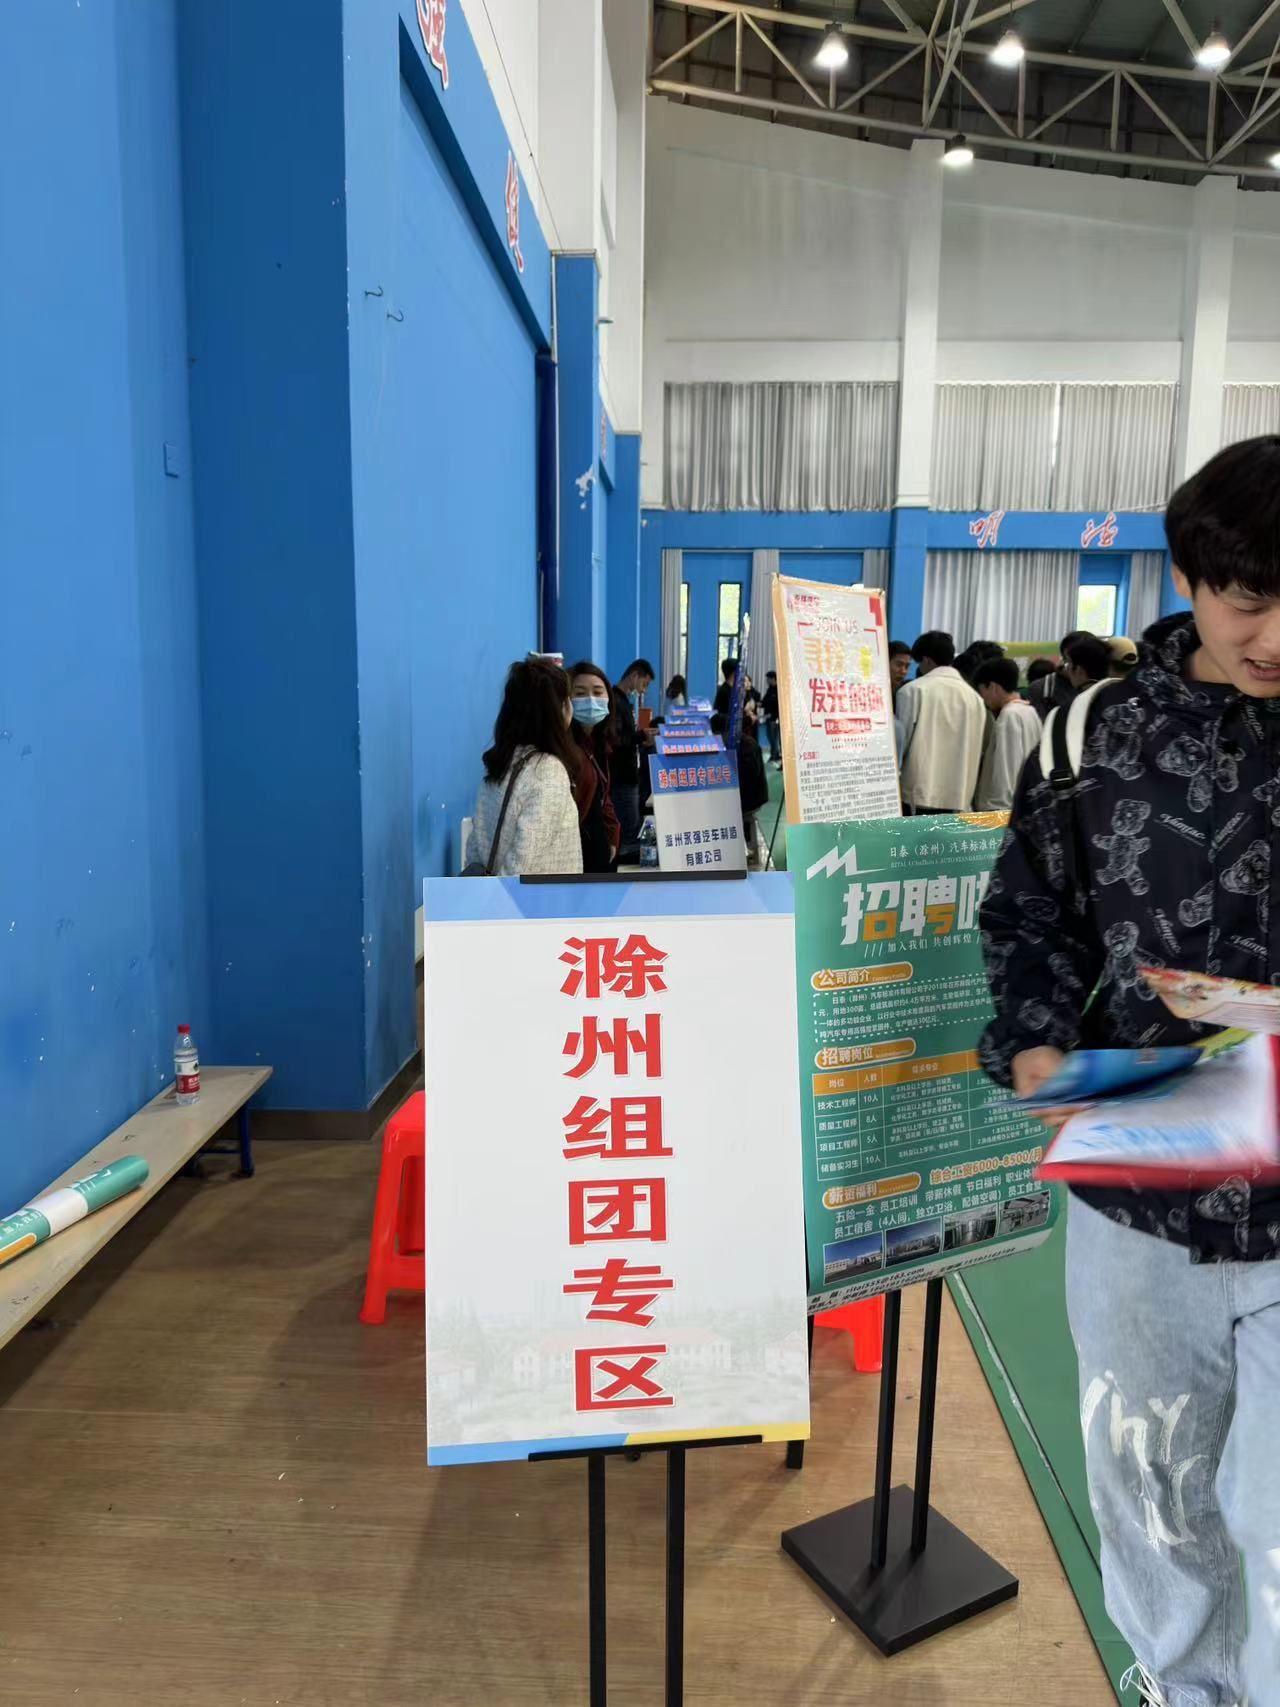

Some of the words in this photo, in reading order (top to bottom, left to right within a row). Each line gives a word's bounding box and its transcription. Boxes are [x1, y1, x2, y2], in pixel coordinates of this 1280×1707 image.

[685, 849, 722, 867] 有限公司
[888, 938, 927, 953] 加入我们
[819, 968, 870, 986] 公司简介
[822, 1047, 873, 1066] 招聘岗位
[818, 1098, 856, 1110] 技术工程师
[864, 1094, 878, 1102] 10人
[820, 1139, 858, 1152] 项目工程师
[867, 1134, 878, 1143] 5人
[821, 1159, 858, 1172] 储备实习生
[866, 1155, 880, 1164] 10人
[557, 933, 675, 1413] 滁州组团专区
[828, 1182, 878, 1205] 薪资福利
[835, 1206, 876, 1225] 五险一金
[879, 1196, 918, 1214] 员工培训
[966, 1174, 1002, 1192] 节日福利
[1005, 1166, 1037, 1184] 职业体
